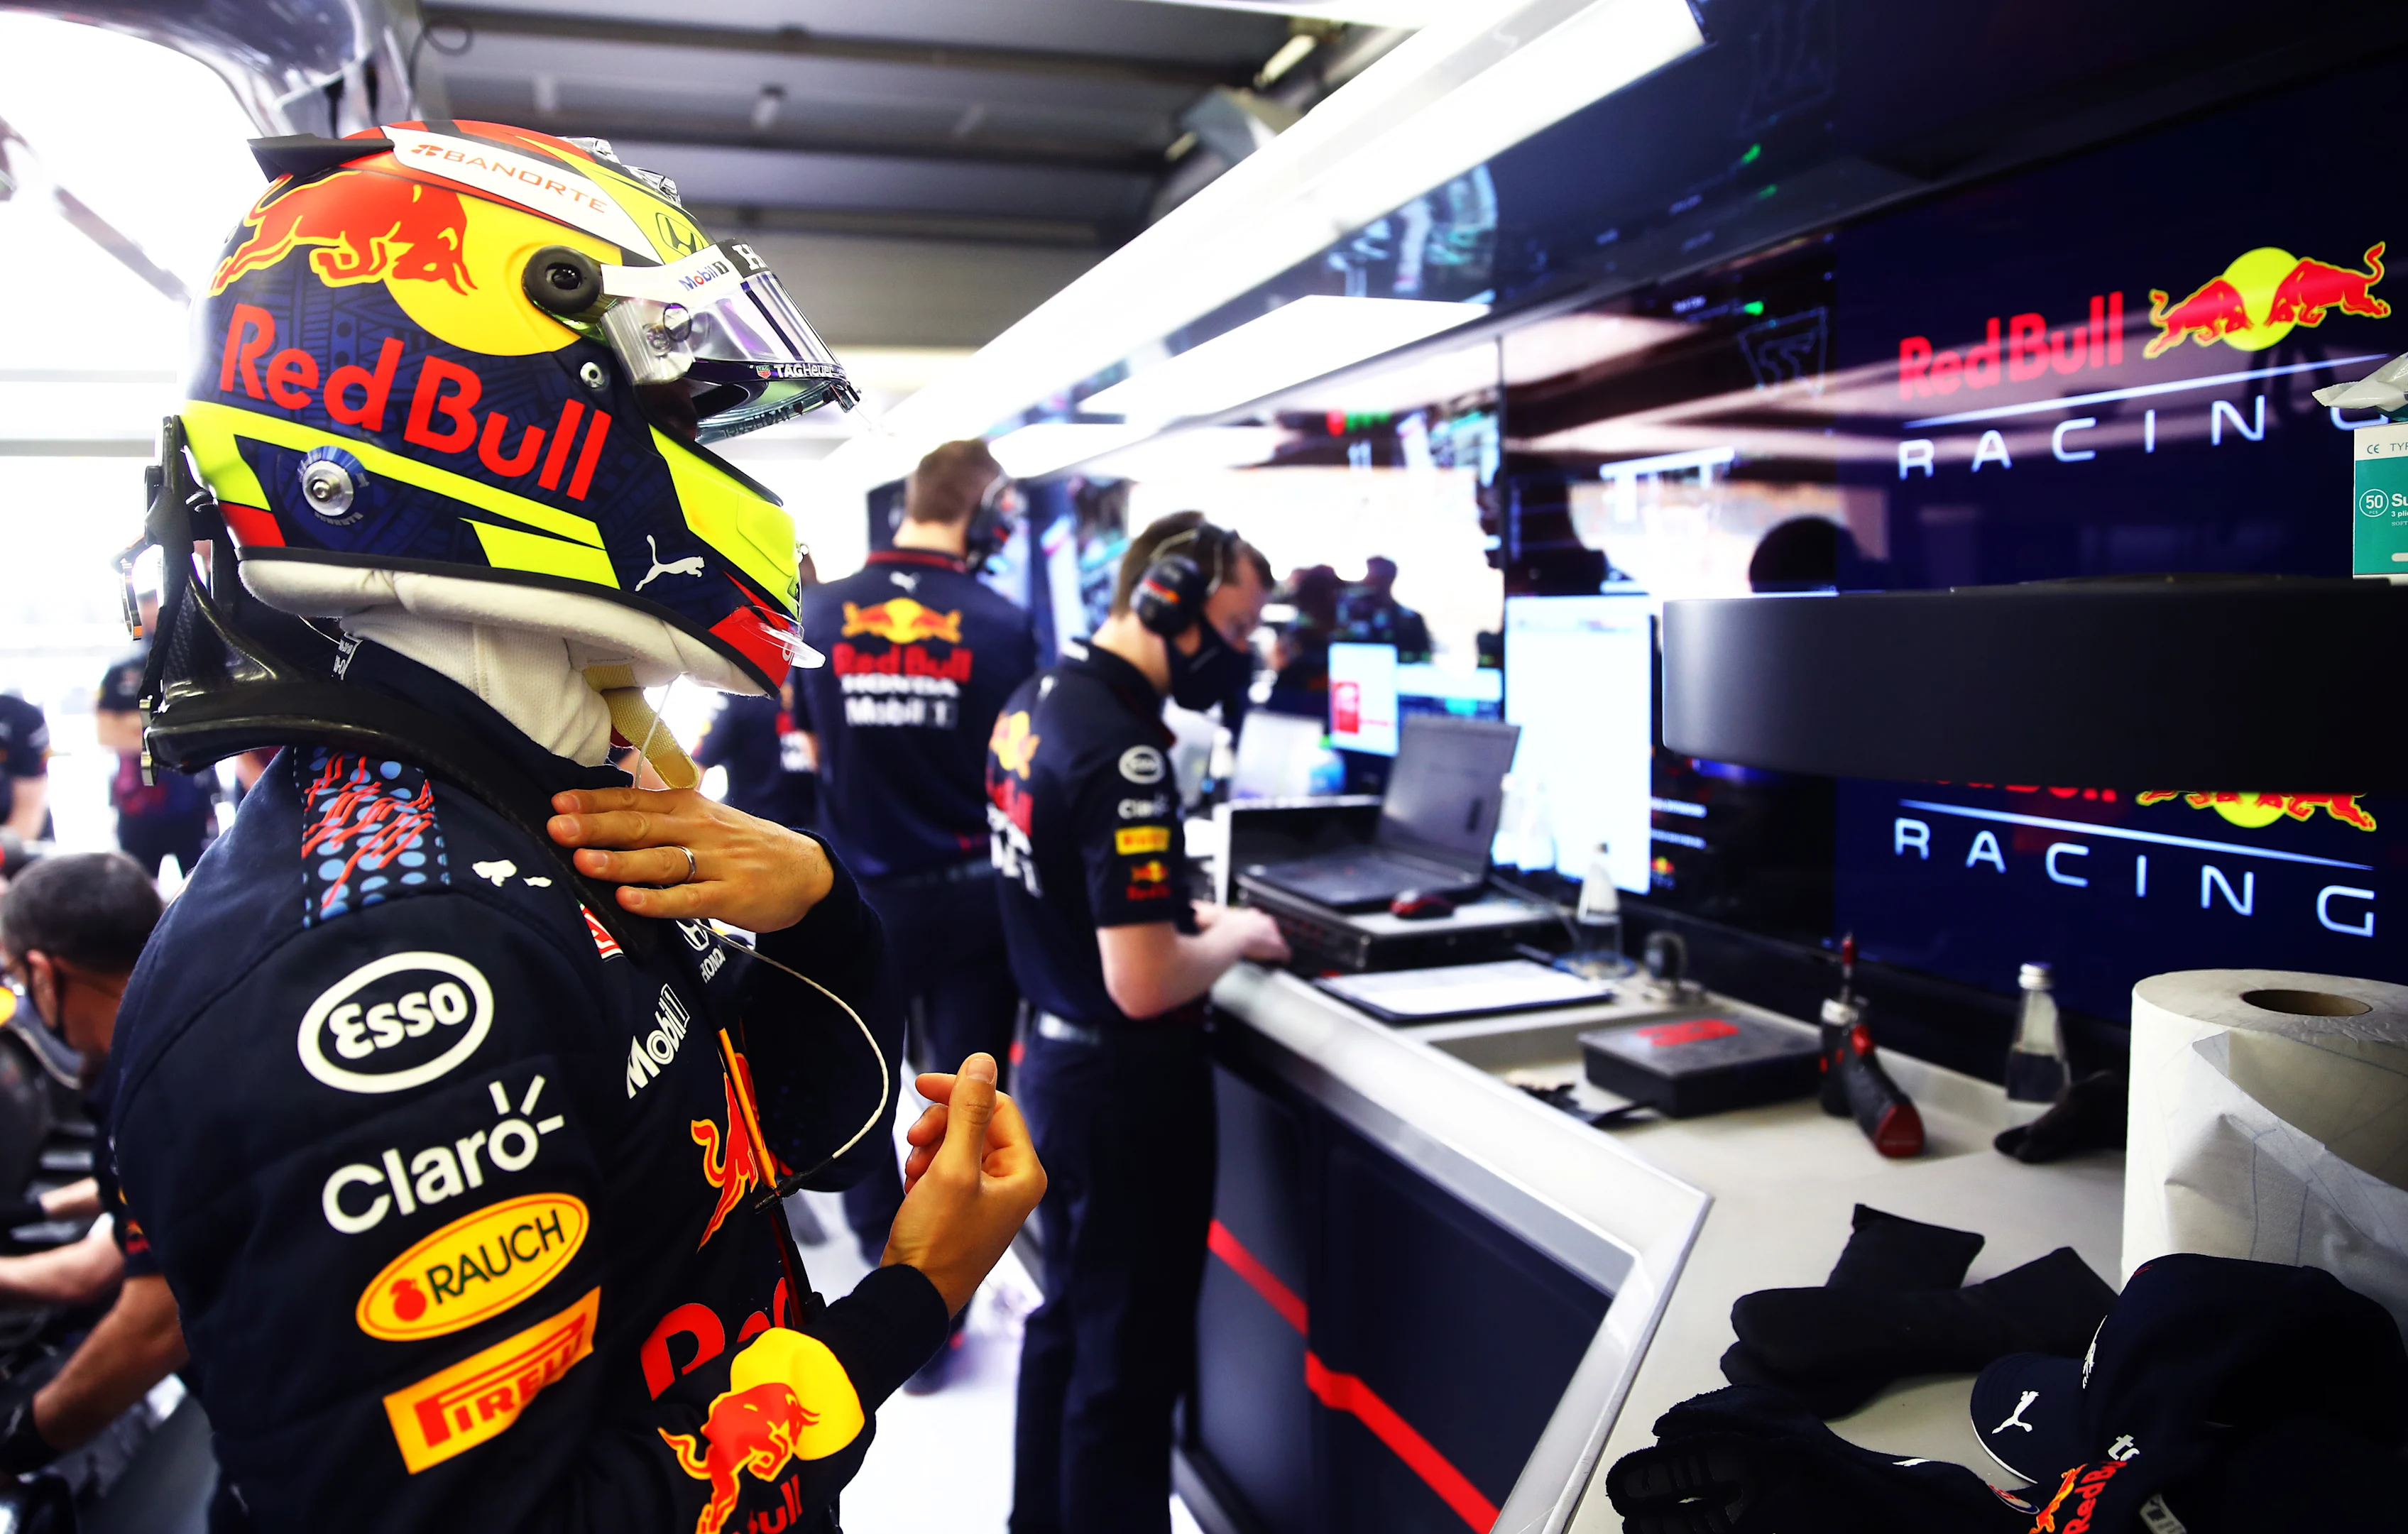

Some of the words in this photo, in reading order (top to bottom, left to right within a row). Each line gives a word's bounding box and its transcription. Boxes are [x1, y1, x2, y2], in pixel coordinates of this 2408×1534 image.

[444, 148, 607, 215] BANORTE
[679, 265, 718, 292] Mobil
[1898, 317, 2001, 401] Red
[2008, 290, 2124, 383] Bull
[219, 303, 404, 433] Red
[403, 355, 612, 502] Bull
[2365, 494, 2384, 509] 50
[2397, 510, 2408, 518] pli
[1894, 817, 2375, 938] RACING
[329, 980, 469, 1060] Esso
[626, 997, 687, 1100] Mobil
[321, 1116, 540, 1235] Claro
[425, 1208, 567, 1306] RAUCH
[412, 1311, 587, 1450] PIRELLI
